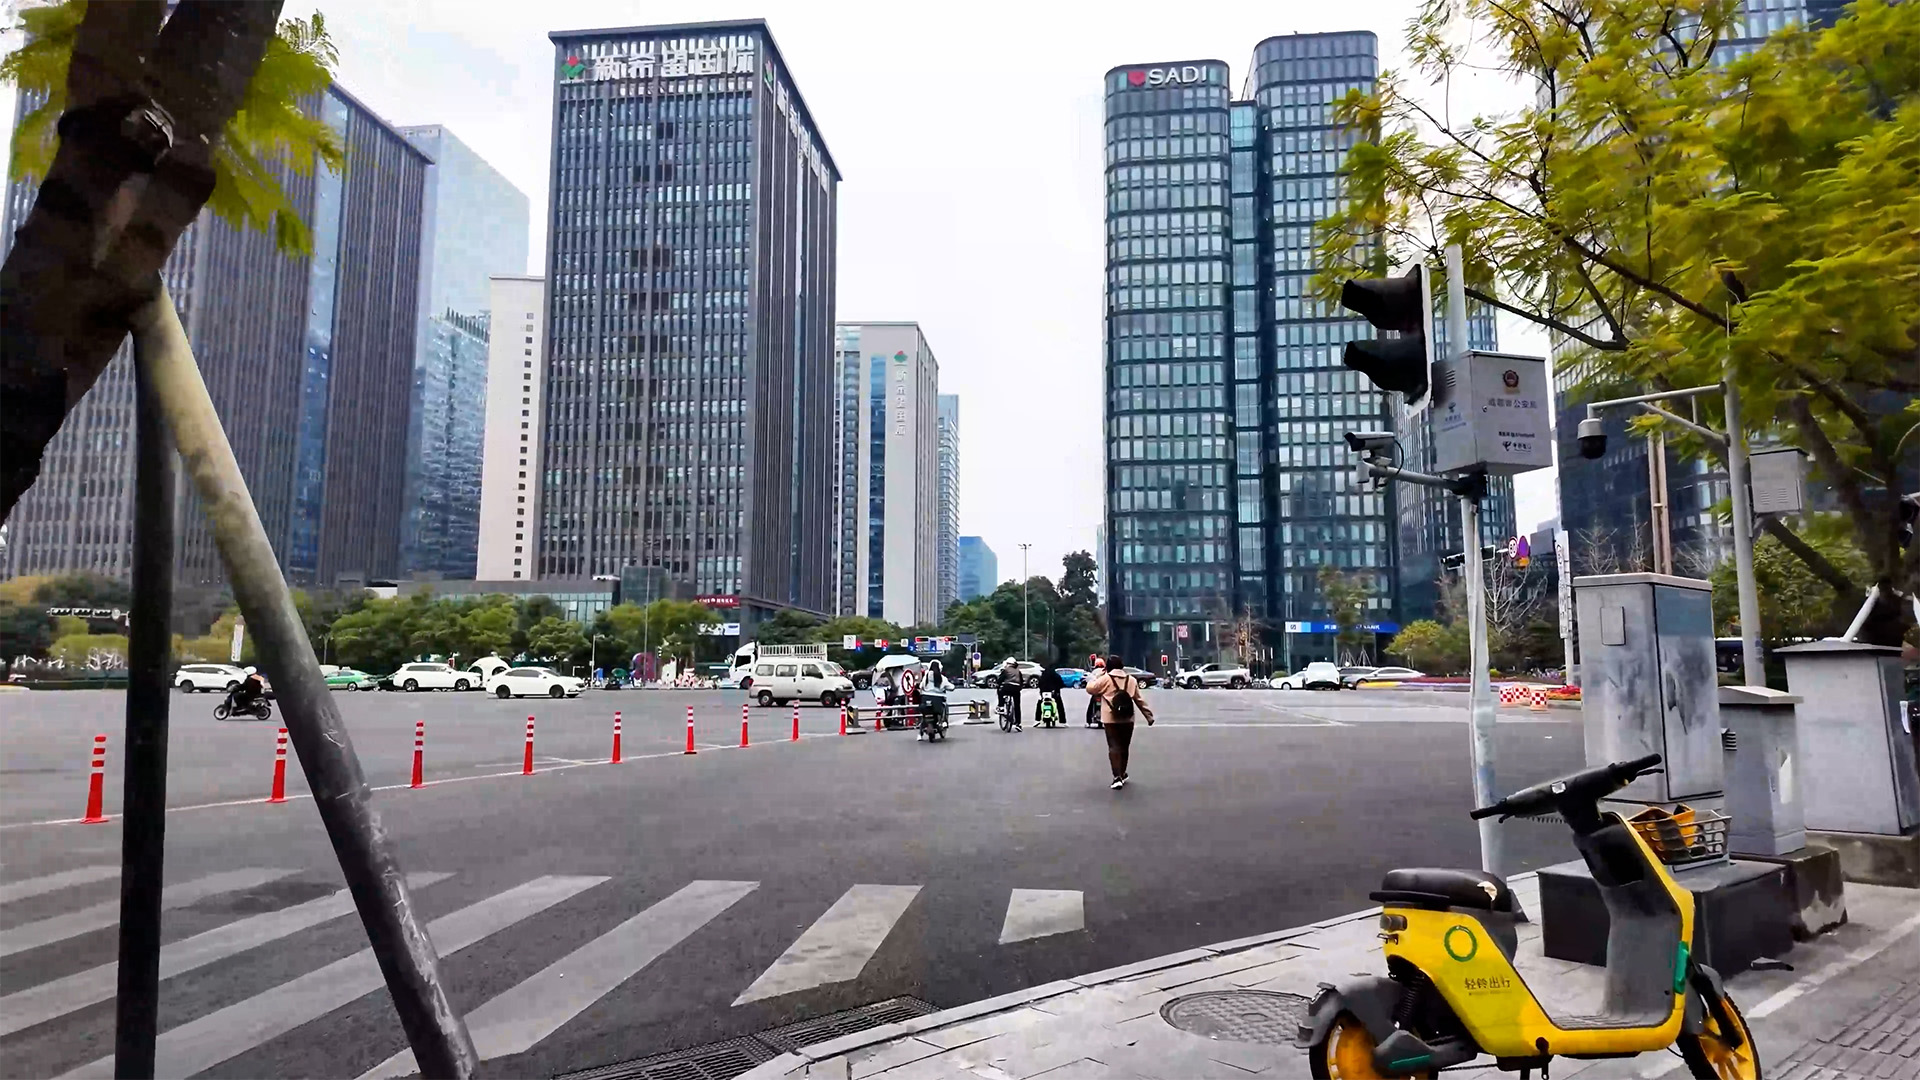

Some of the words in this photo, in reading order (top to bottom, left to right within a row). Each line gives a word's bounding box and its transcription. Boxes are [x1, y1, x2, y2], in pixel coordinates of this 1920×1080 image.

[594, 48, 754, 81] 新希望国际
[1149, 65, 1207, 85] SADI
